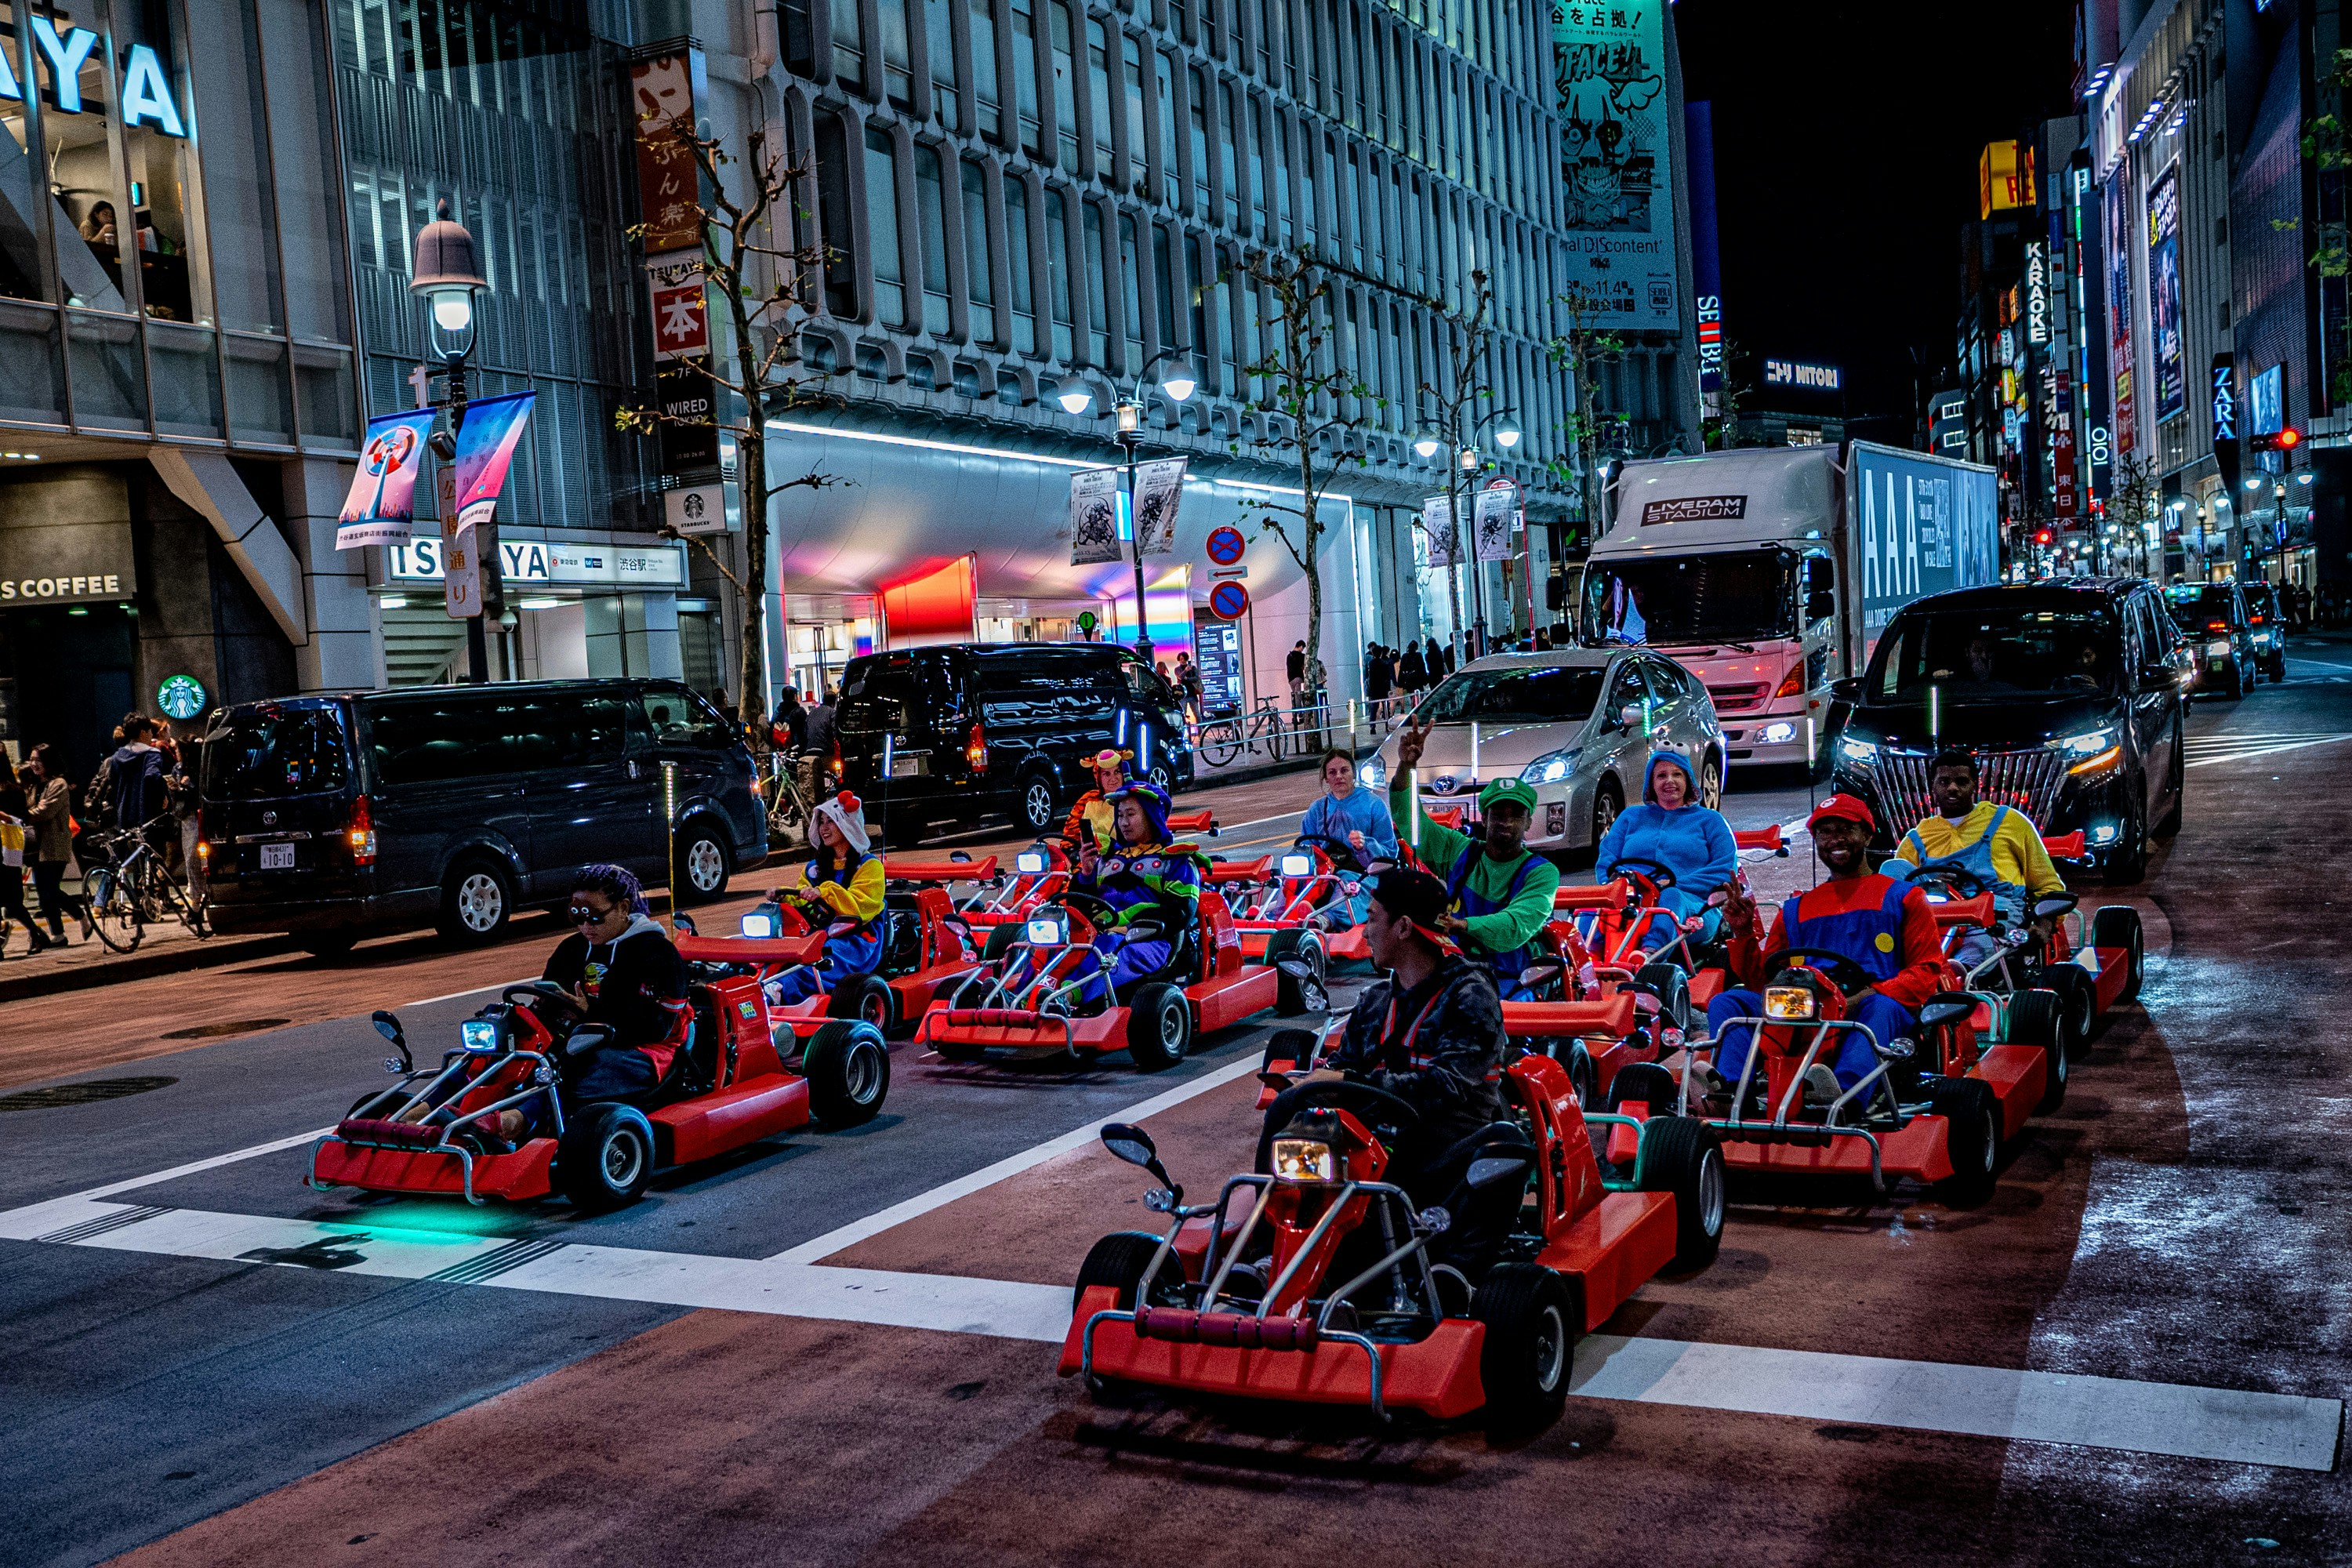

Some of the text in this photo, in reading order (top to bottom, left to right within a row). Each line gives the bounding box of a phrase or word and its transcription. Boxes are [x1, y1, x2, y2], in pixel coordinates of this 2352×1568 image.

[2026, 242, 2048, 343] KARAOKE
[662, 296, 699, 342] 本
[1697, 295, 1722, 376] SEIBU
[677, 367, 691, 379] 7F
[1767, 361, 1838, 388] ニトリ NITORI
[666, 398, 708, 416] WIRED
[2213, 366, 2236, 440] ZARA
[1647, 507, 1740, 522] STADIUM
[1864, 469, 1920, 599] AAA
[619, 557, 647, 572] 渋谷駅
[20, 575, 118, 597] COFFEE
[1503, 779, 1512, 789] L
[269, 853, 292, 866] 10-10
